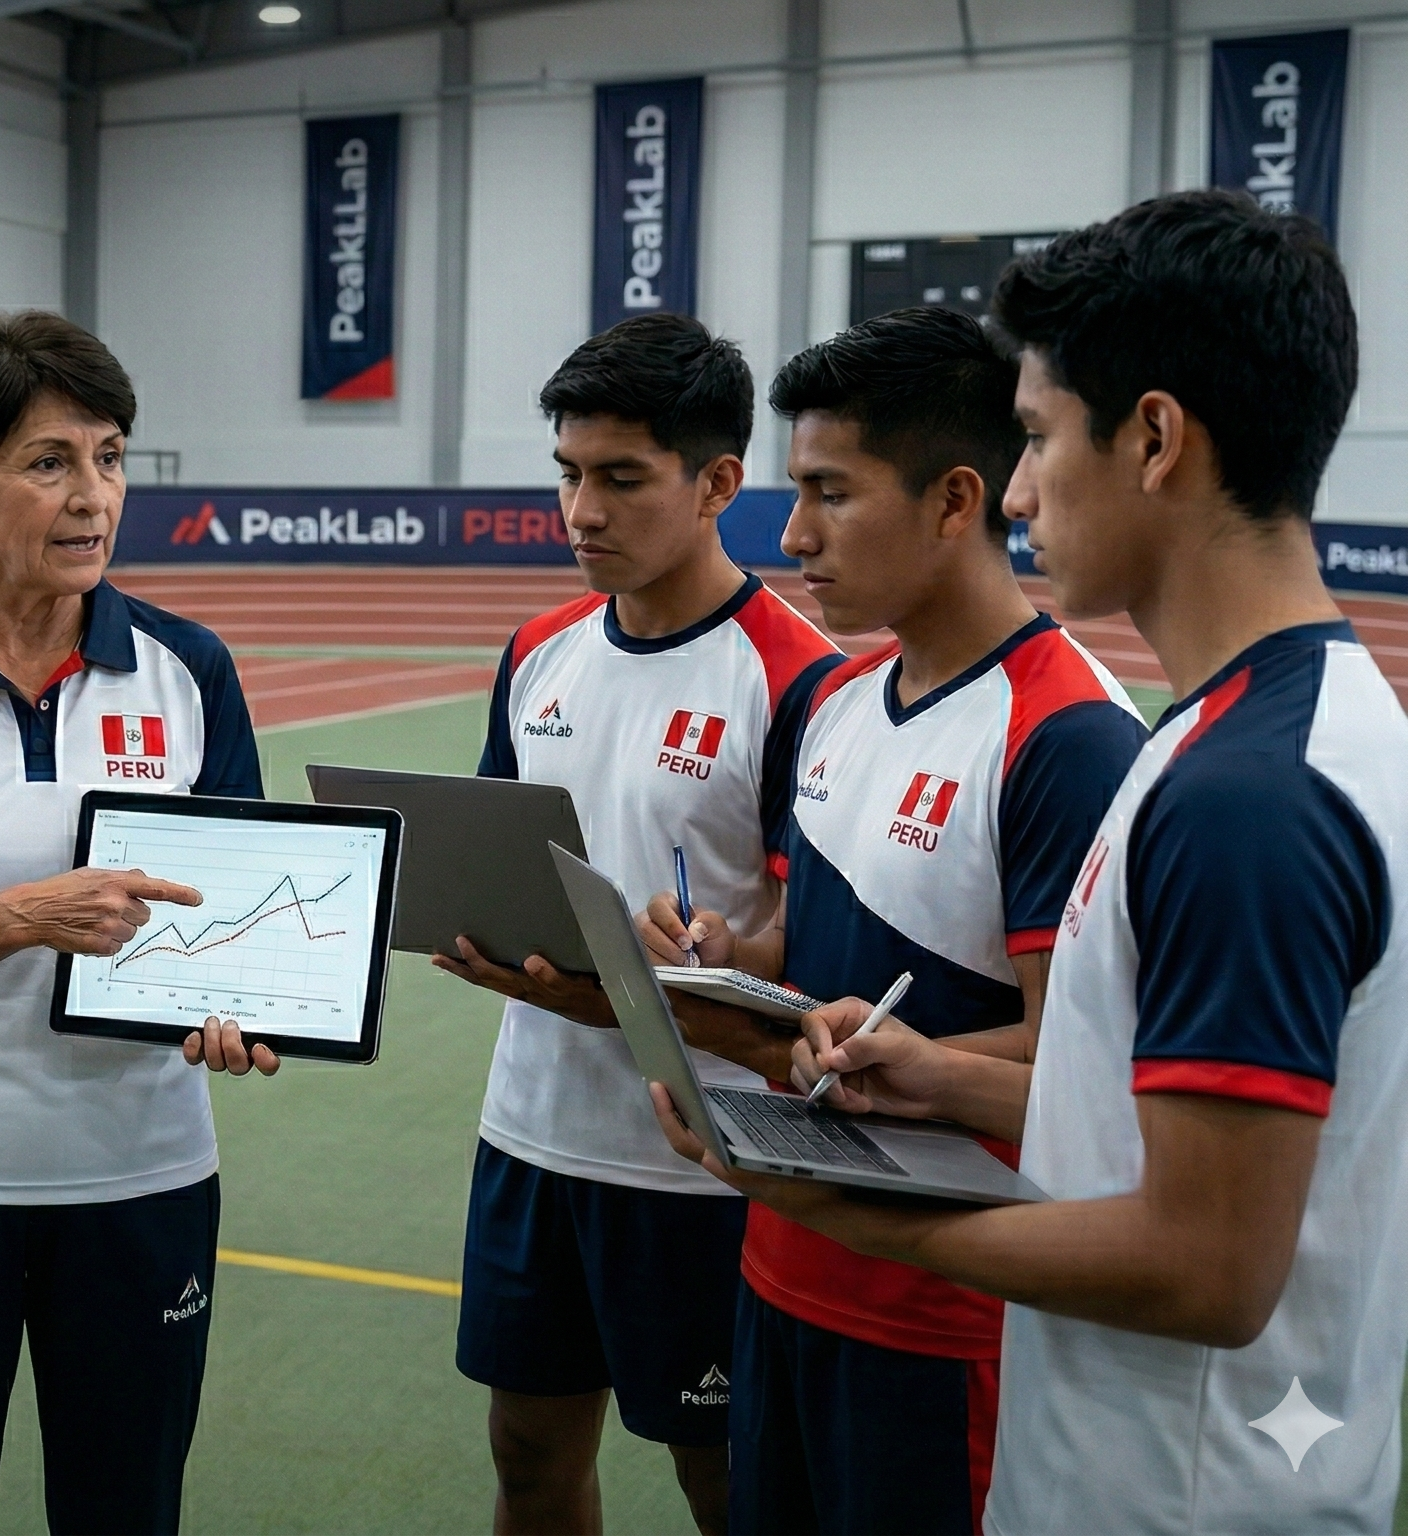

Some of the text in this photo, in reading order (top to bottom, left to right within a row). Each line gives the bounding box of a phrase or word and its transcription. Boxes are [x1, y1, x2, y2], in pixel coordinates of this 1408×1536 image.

[622, 104, 666, 308] PeakLab
[240, 506, 425, 545] PeakLab
[523, 719, 573, 738] PeakLab
[106, 760, 165, 779] PERU
[657, 751, 712, 780] PERU
[888, 820, 939, 853] PERU
